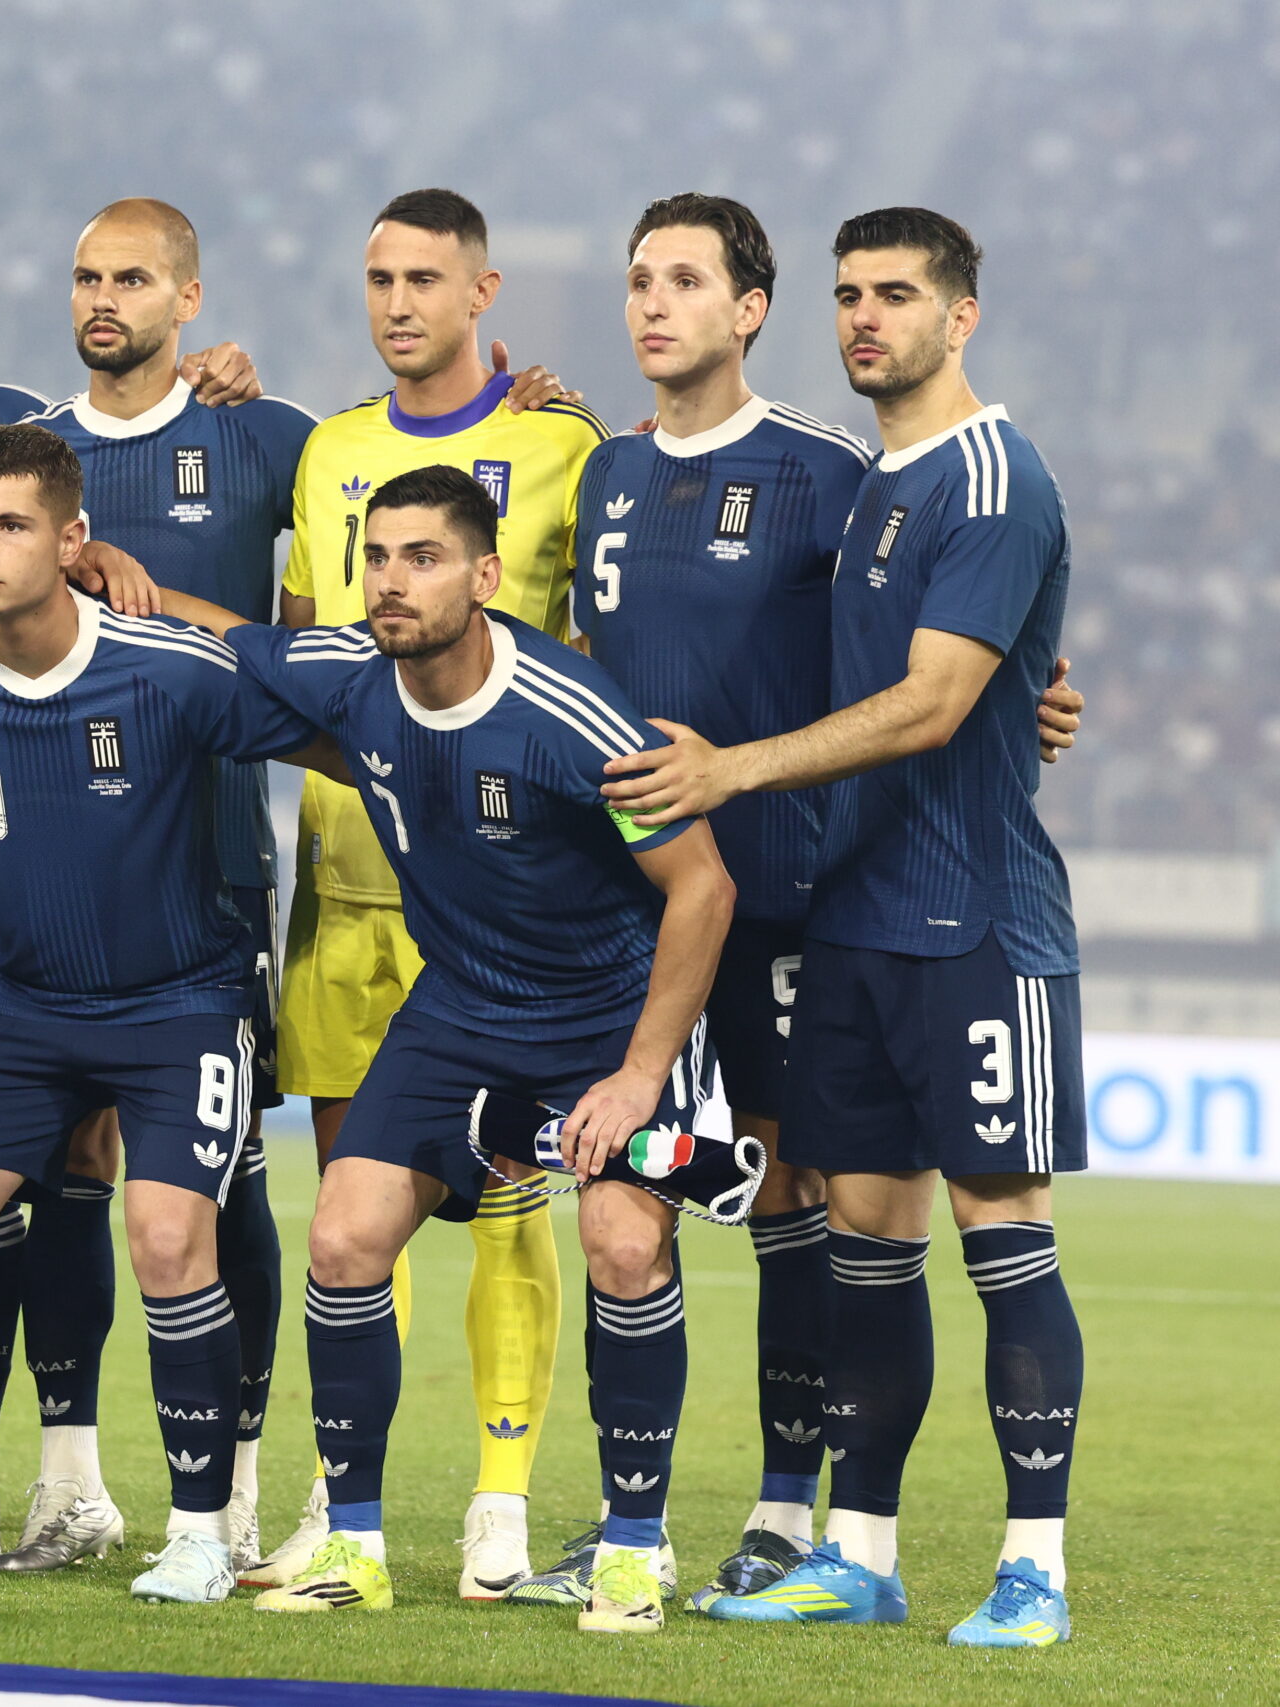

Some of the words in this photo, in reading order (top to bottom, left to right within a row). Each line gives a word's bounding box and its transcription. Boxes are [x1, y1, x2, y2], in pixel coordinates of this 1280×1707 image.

[344, 514, 359, 587] 1
[593, 532, 627, 613] 5
[370, 780, 410, 854] 7
[197, 1052, 235, 1132] 8
[967, 1019, 1014, 1104] 3
[157, 1401, 219, 1421] ΕΛΛΑΣ
[613, 1427, 674, 1441] ΕΛΛΑΣ
[996, 1405, 1074, 1421] ΕΛΛΑΣ
